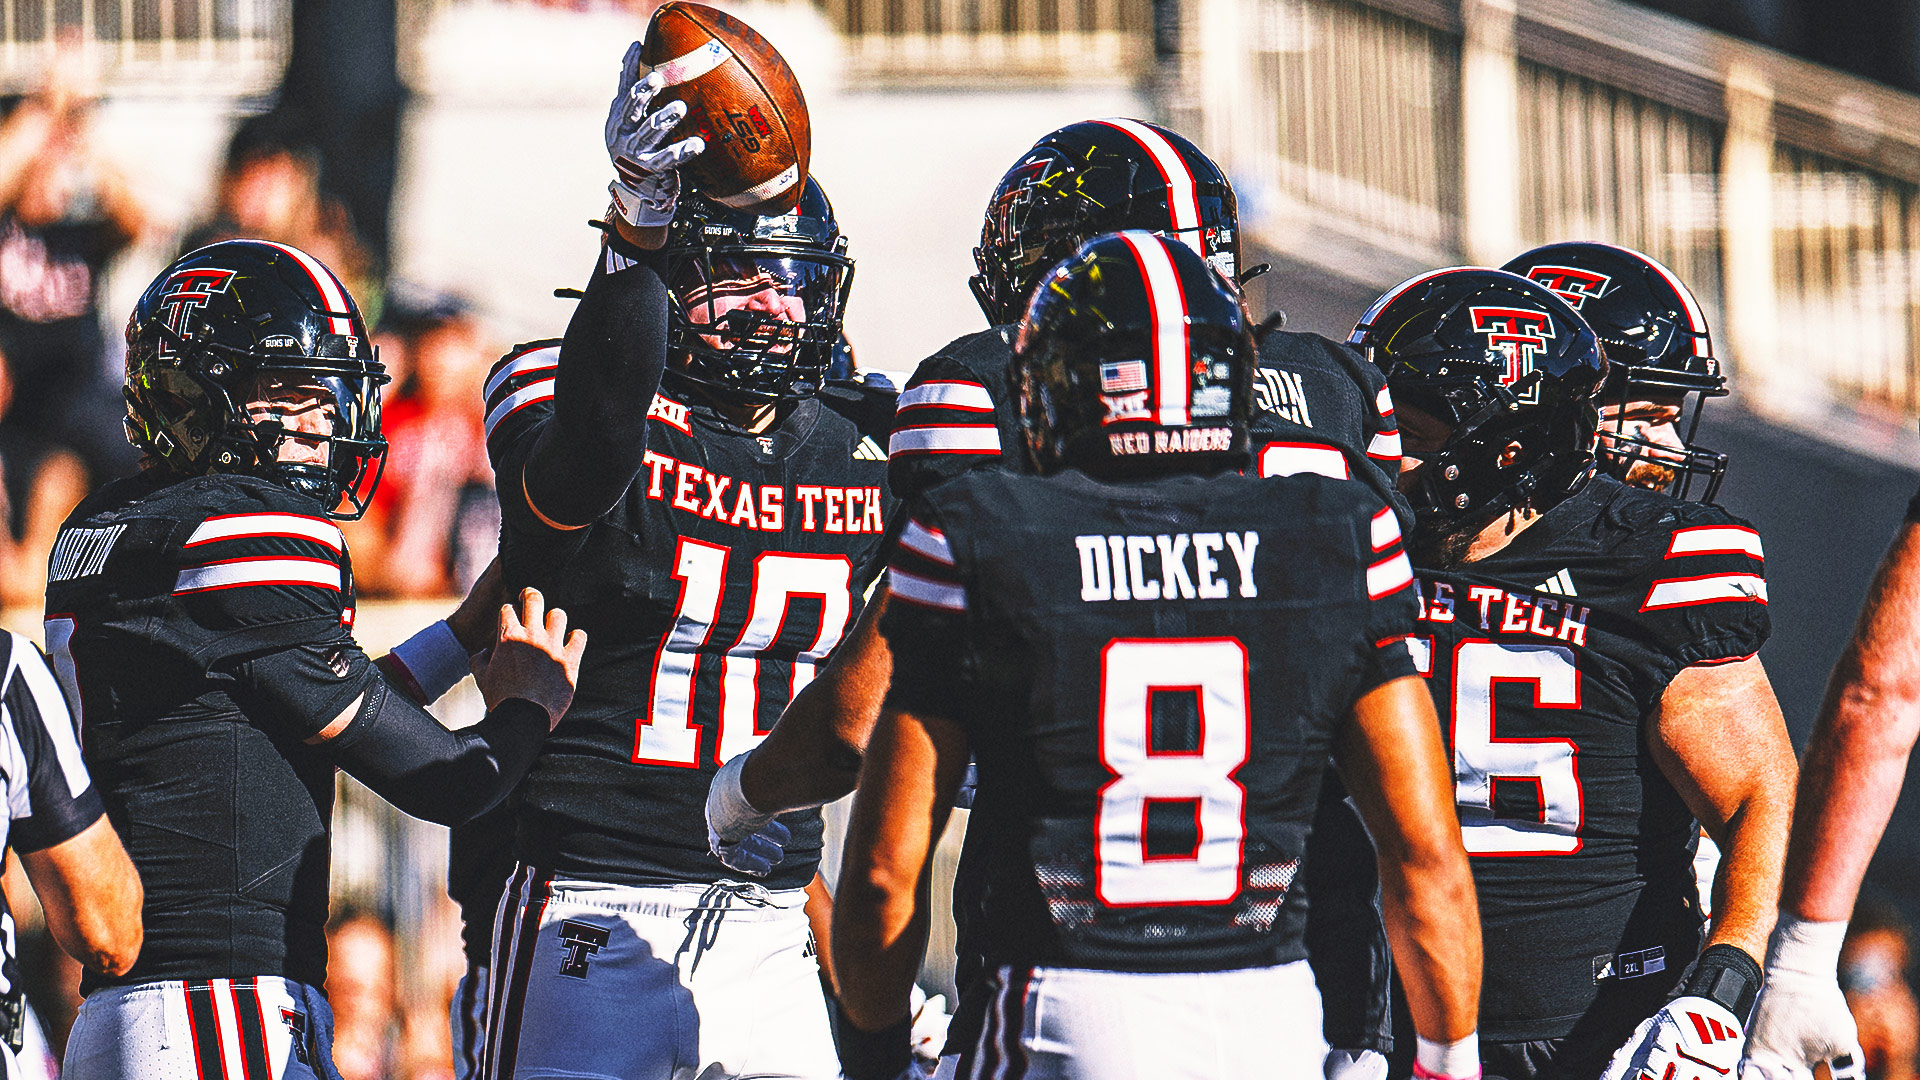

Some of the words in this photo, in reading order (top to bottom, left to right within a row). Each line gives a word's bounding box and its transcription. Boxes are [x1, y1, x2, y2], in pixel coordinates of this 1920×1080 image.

[722, 108, 761, 154] GST
[704, 226, 722, 236] GUNS
[722, 227, 733, 237] UP
[265, 338, 284, 348] GUNS
[284, 338, 295, 348] UP
[1108, 431, 1150, 456] RED
[1154, 427, 1233, 454] RAIDERS
[642, 448, 785, 533] TEXAS
[796, 484, 884, 535] TECH
[48, 523, 128, 584] MORTON
[1075, 531, 1259, 602] DICKEY
[1467, 584, 1591, 648] TECH
[631, 534, 853, 769] 10
[1094, 636, 1252, 909] 8
[1624, 961, 1640, 974] 2XL
